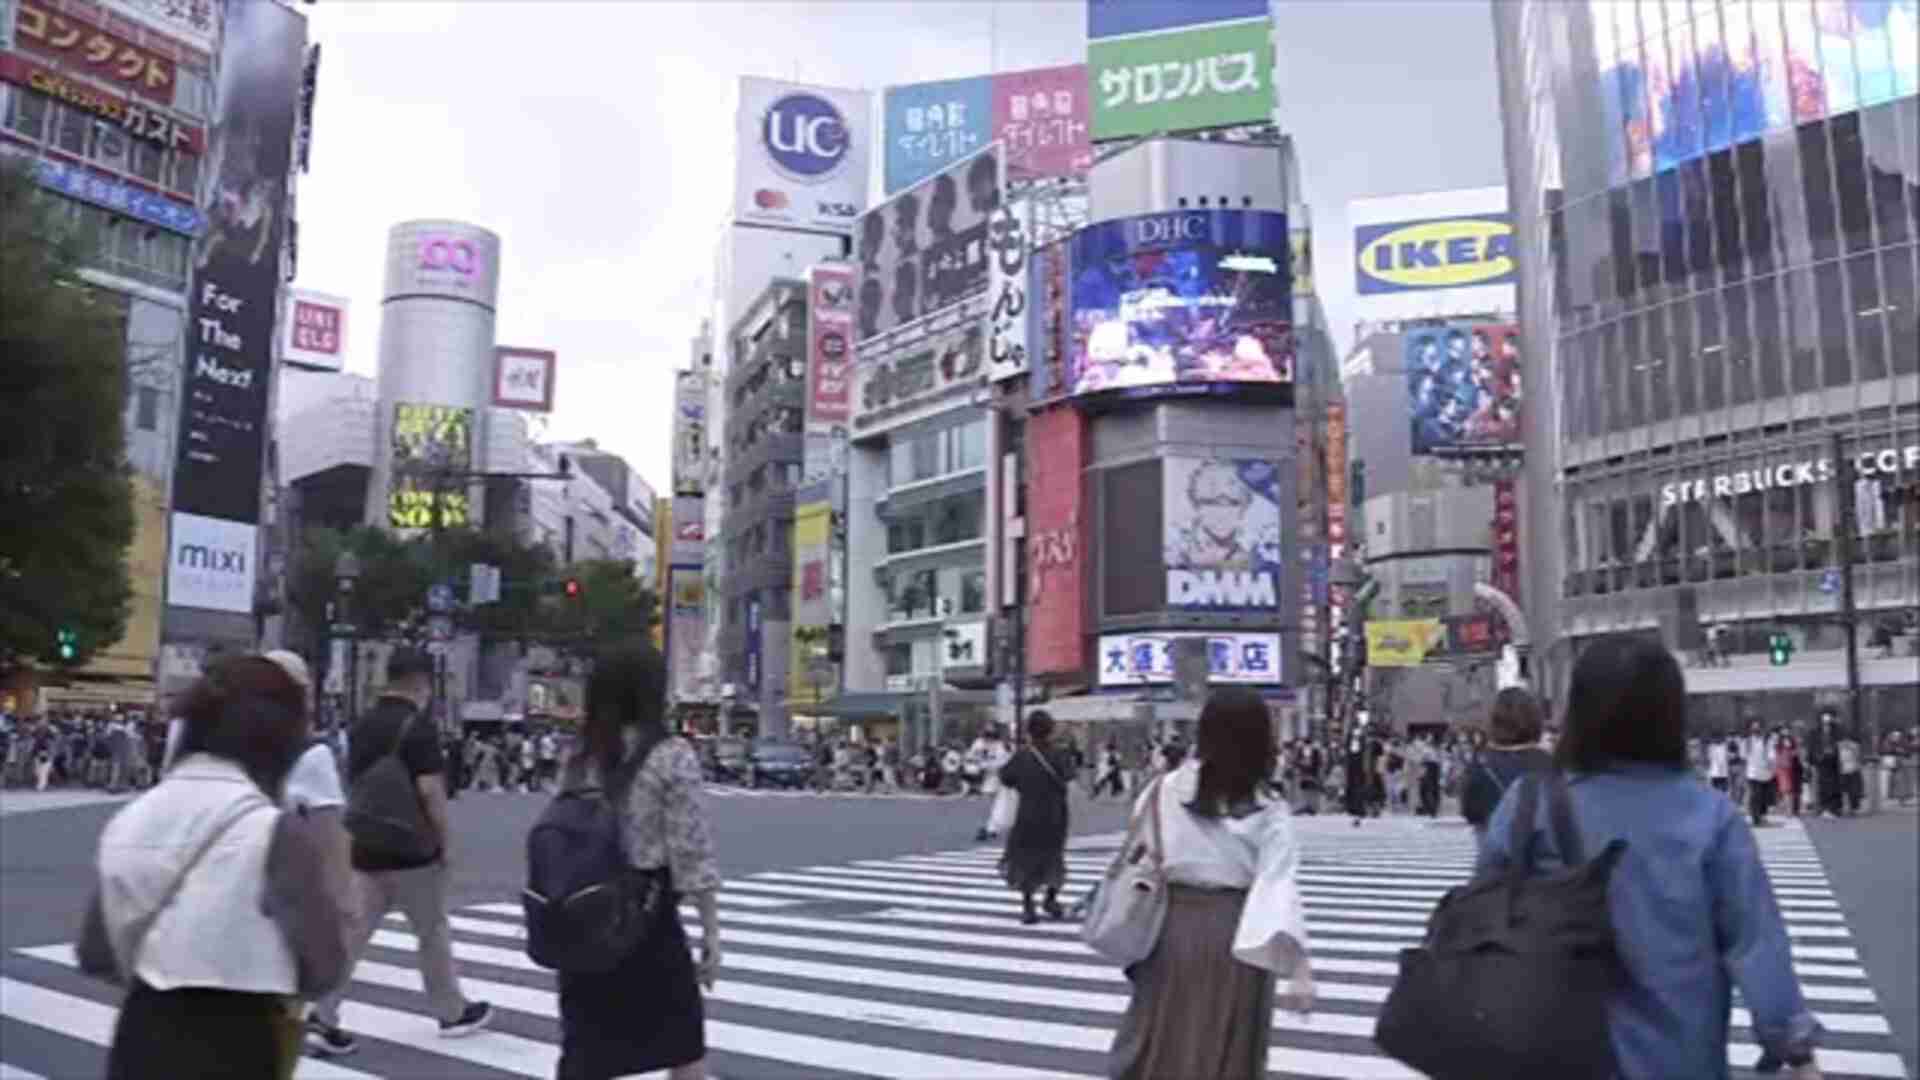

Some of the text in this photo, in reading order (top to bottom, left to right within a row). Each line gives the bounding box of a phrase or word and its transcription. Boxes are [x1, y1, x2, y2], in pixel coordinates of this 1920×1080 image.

[20, 5, 169, 88] コンタクト
[1100, 50, 1260, 107] サロンパス
[770, 110, 842, 158] UC
[1138, 215, 1206, 241] DHC
[203, 283, 243, 313] For
[200, 318, 241, 350] The
[196, 355, 254, 388] Next
[1662, 458, 1836, 505] STARBUCKS
[179, 545, 245, 573] mixi
[1167, 570, 1277, 607] DMM
